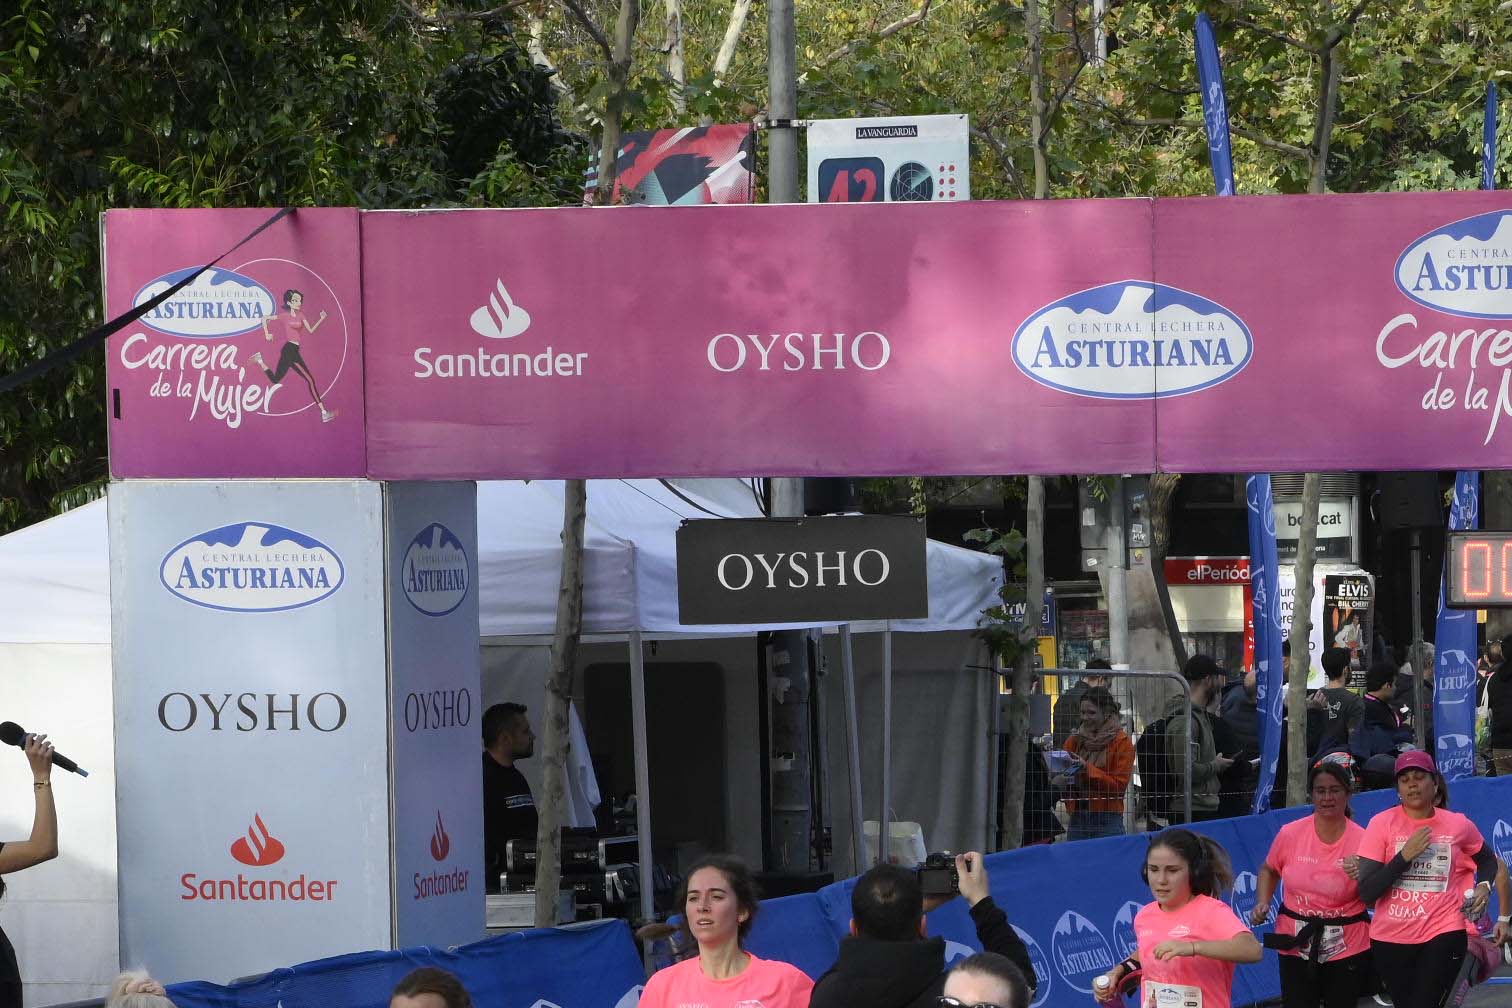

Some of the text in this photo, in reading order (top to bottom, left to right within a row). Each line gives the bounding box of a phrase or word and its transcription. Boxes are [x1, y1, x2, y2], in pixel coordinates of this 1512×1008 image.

[213, 289, 261, 298] LECHERA
[1067, 321, 1225, 335] CENTRAL LECHERA
[120, 332, 238, 370] Carrera
[414, 346, 588, 379] Santander
[707, 331, 891, 372] OYSHO
[1031, 325, 1234, 368] ASTURIANA
[150, 366, 283, 429] de la Mujer
[1421, 372, 1456, 411] de
[1464, 370, 1489, 411] la
[175, 555, 331, 590] ASTURIANA
[202, 553, 326, 562] CENTRAL LECHERA
[717, 549, 890, 591] OYSHO
[407, 558, 465, 593] ASTURIANA
[1338, 583, 1369, 597] ELVIS
[157, 692, 347, 732] OYSHO
[404, 688, 471, 733] OYSHO
[413, 866, 470, 900] Santander
[1414, 862, 1432, 870] 016
[181, 873, 338, 901] Santander
[1058, 945, 1112, 977] ASTURIANA
